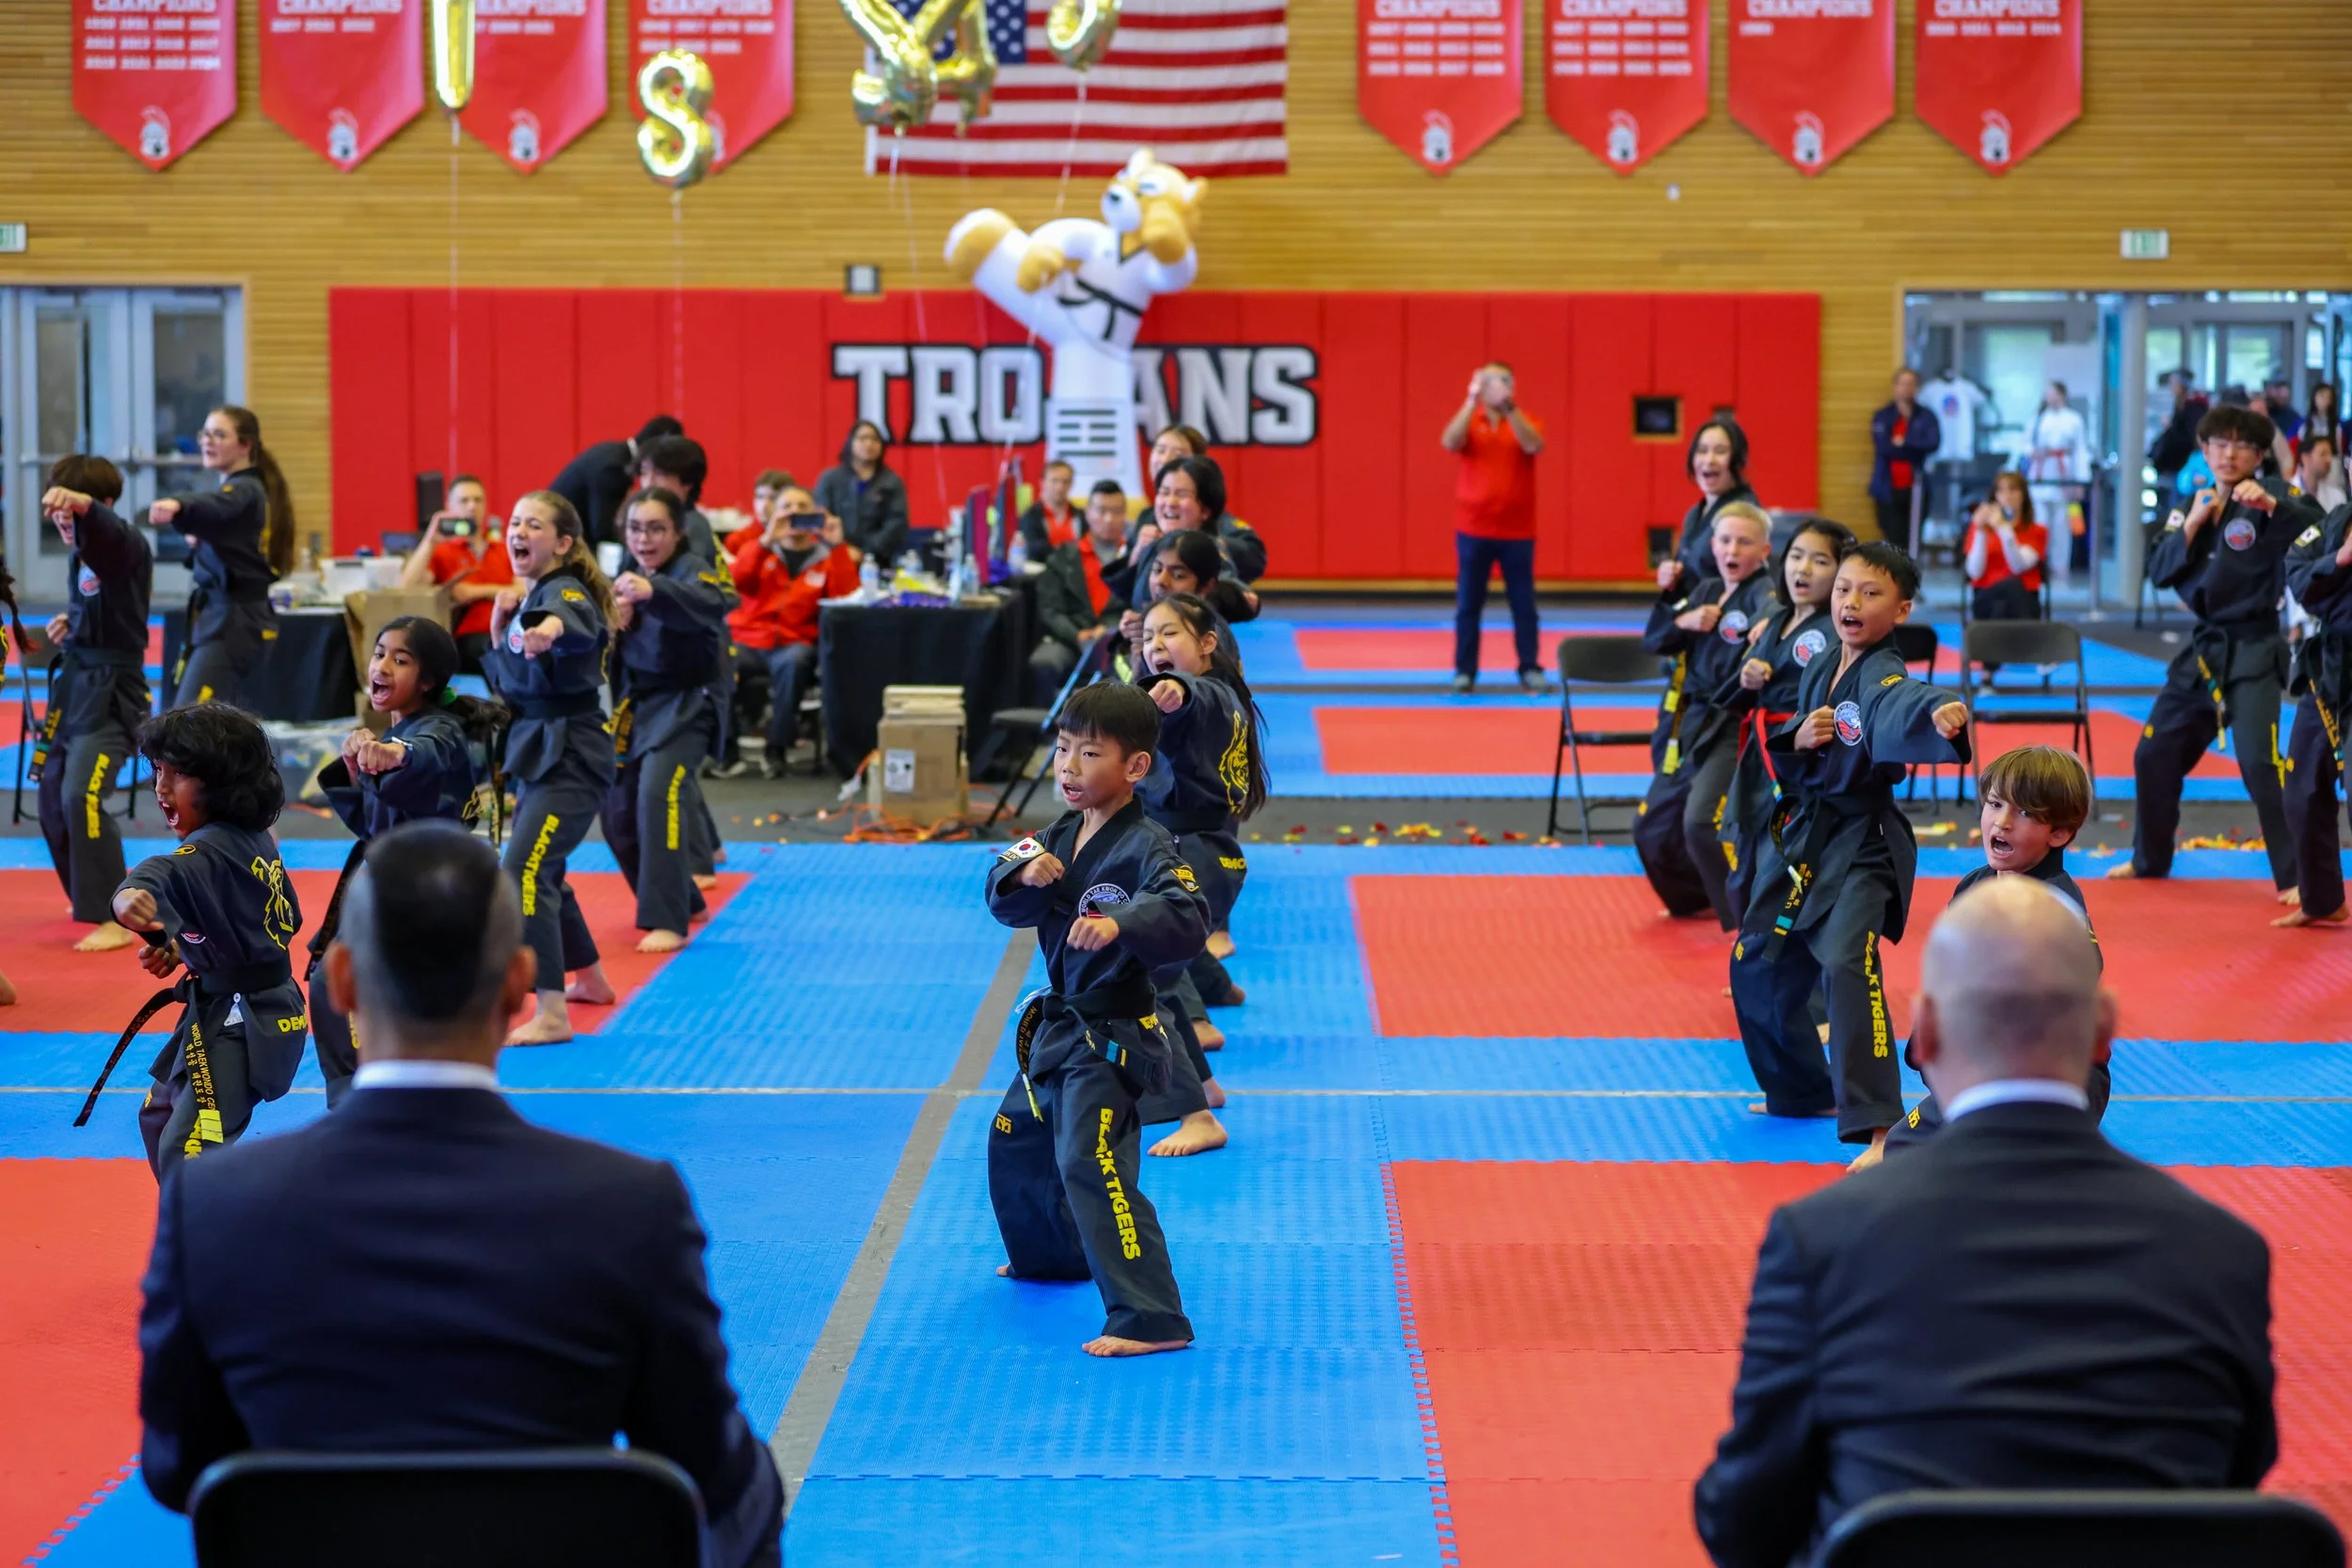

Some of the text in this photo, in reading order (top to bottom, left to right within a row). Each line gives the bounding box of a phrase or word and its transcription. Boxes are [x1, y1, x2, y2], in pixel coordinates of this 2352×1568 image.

[833, 344, 1317, 444] TROANS
[191, 1022, 203, 1047] WORLD
[277, 1015, 309, 1033] DEM
[1869, 989, 1888, 1058] TIGERS
[196, 1048, 215, 1096] TAEKWONDO
[1105, 1177, 1141, 1260] TIGERS
